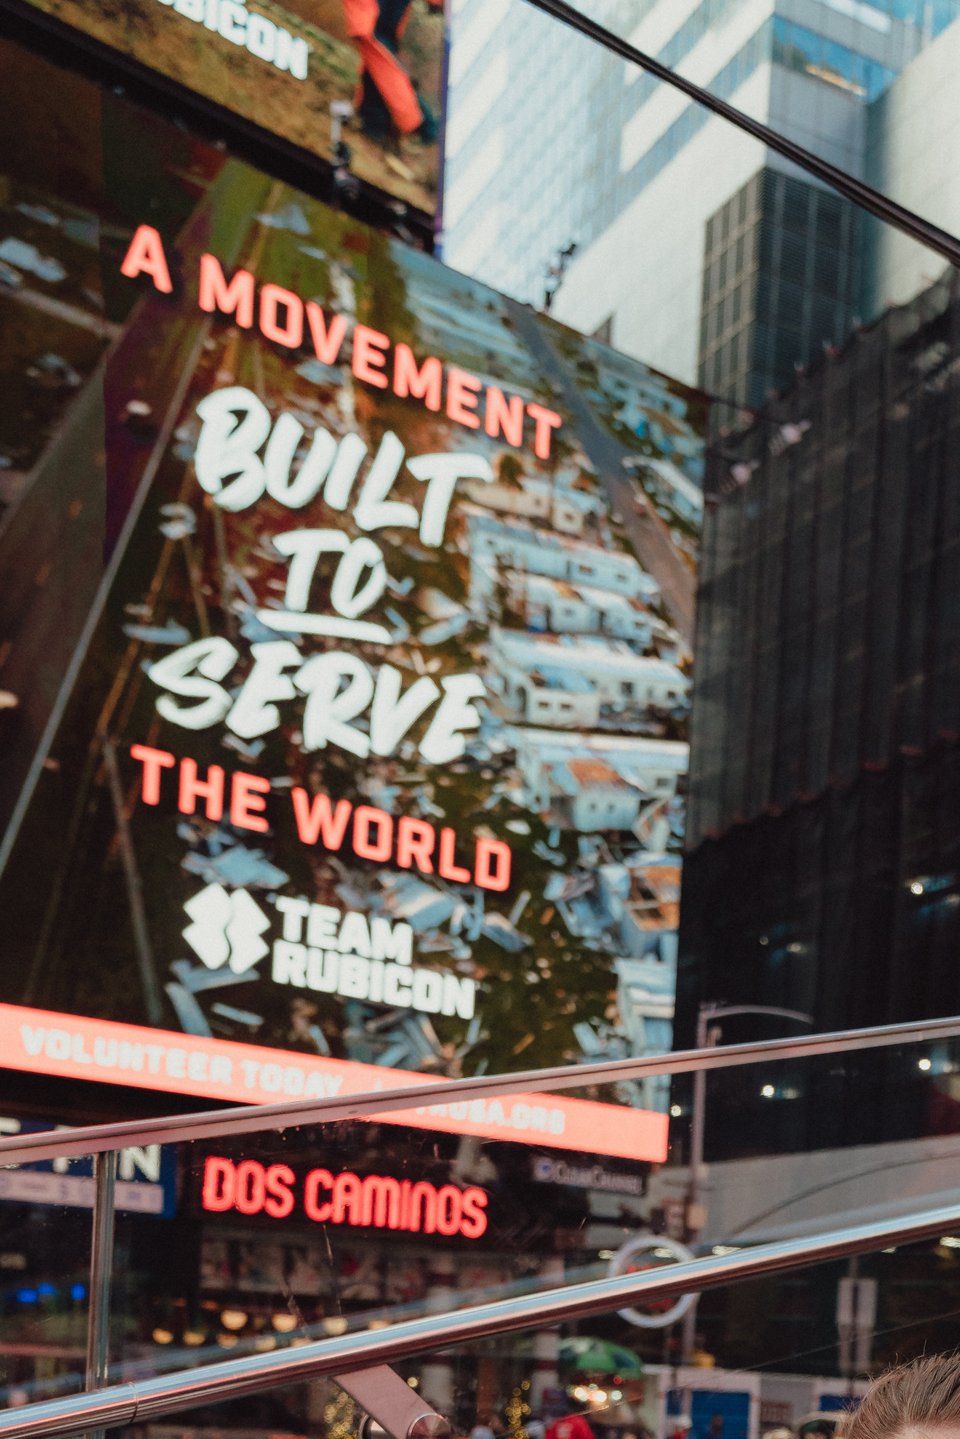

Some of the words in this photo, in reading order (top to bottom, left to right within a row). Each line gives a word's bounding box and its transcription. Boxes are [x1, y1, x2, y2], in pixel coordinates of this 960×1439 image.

[121, 225, 173, 293] A
[199, 253, 563, 460] MOVEMENT
[195, 386, 495, 547] BUILT
[273, 529, 387, 619] TO
[149, 636, 487, 765] SERVE
[130, 743, 271, 834] THE
[291, 786, 512, 893] WORLD
[275, 896, 413, 964] TEAM
[272, 938, 476, 1020] RUBICON
[20, 1023, 233, 1086] VOLUNTEER
[241, 1059, 345, 1099] TODAY
[202, 1155, 296, 1220] DOS
